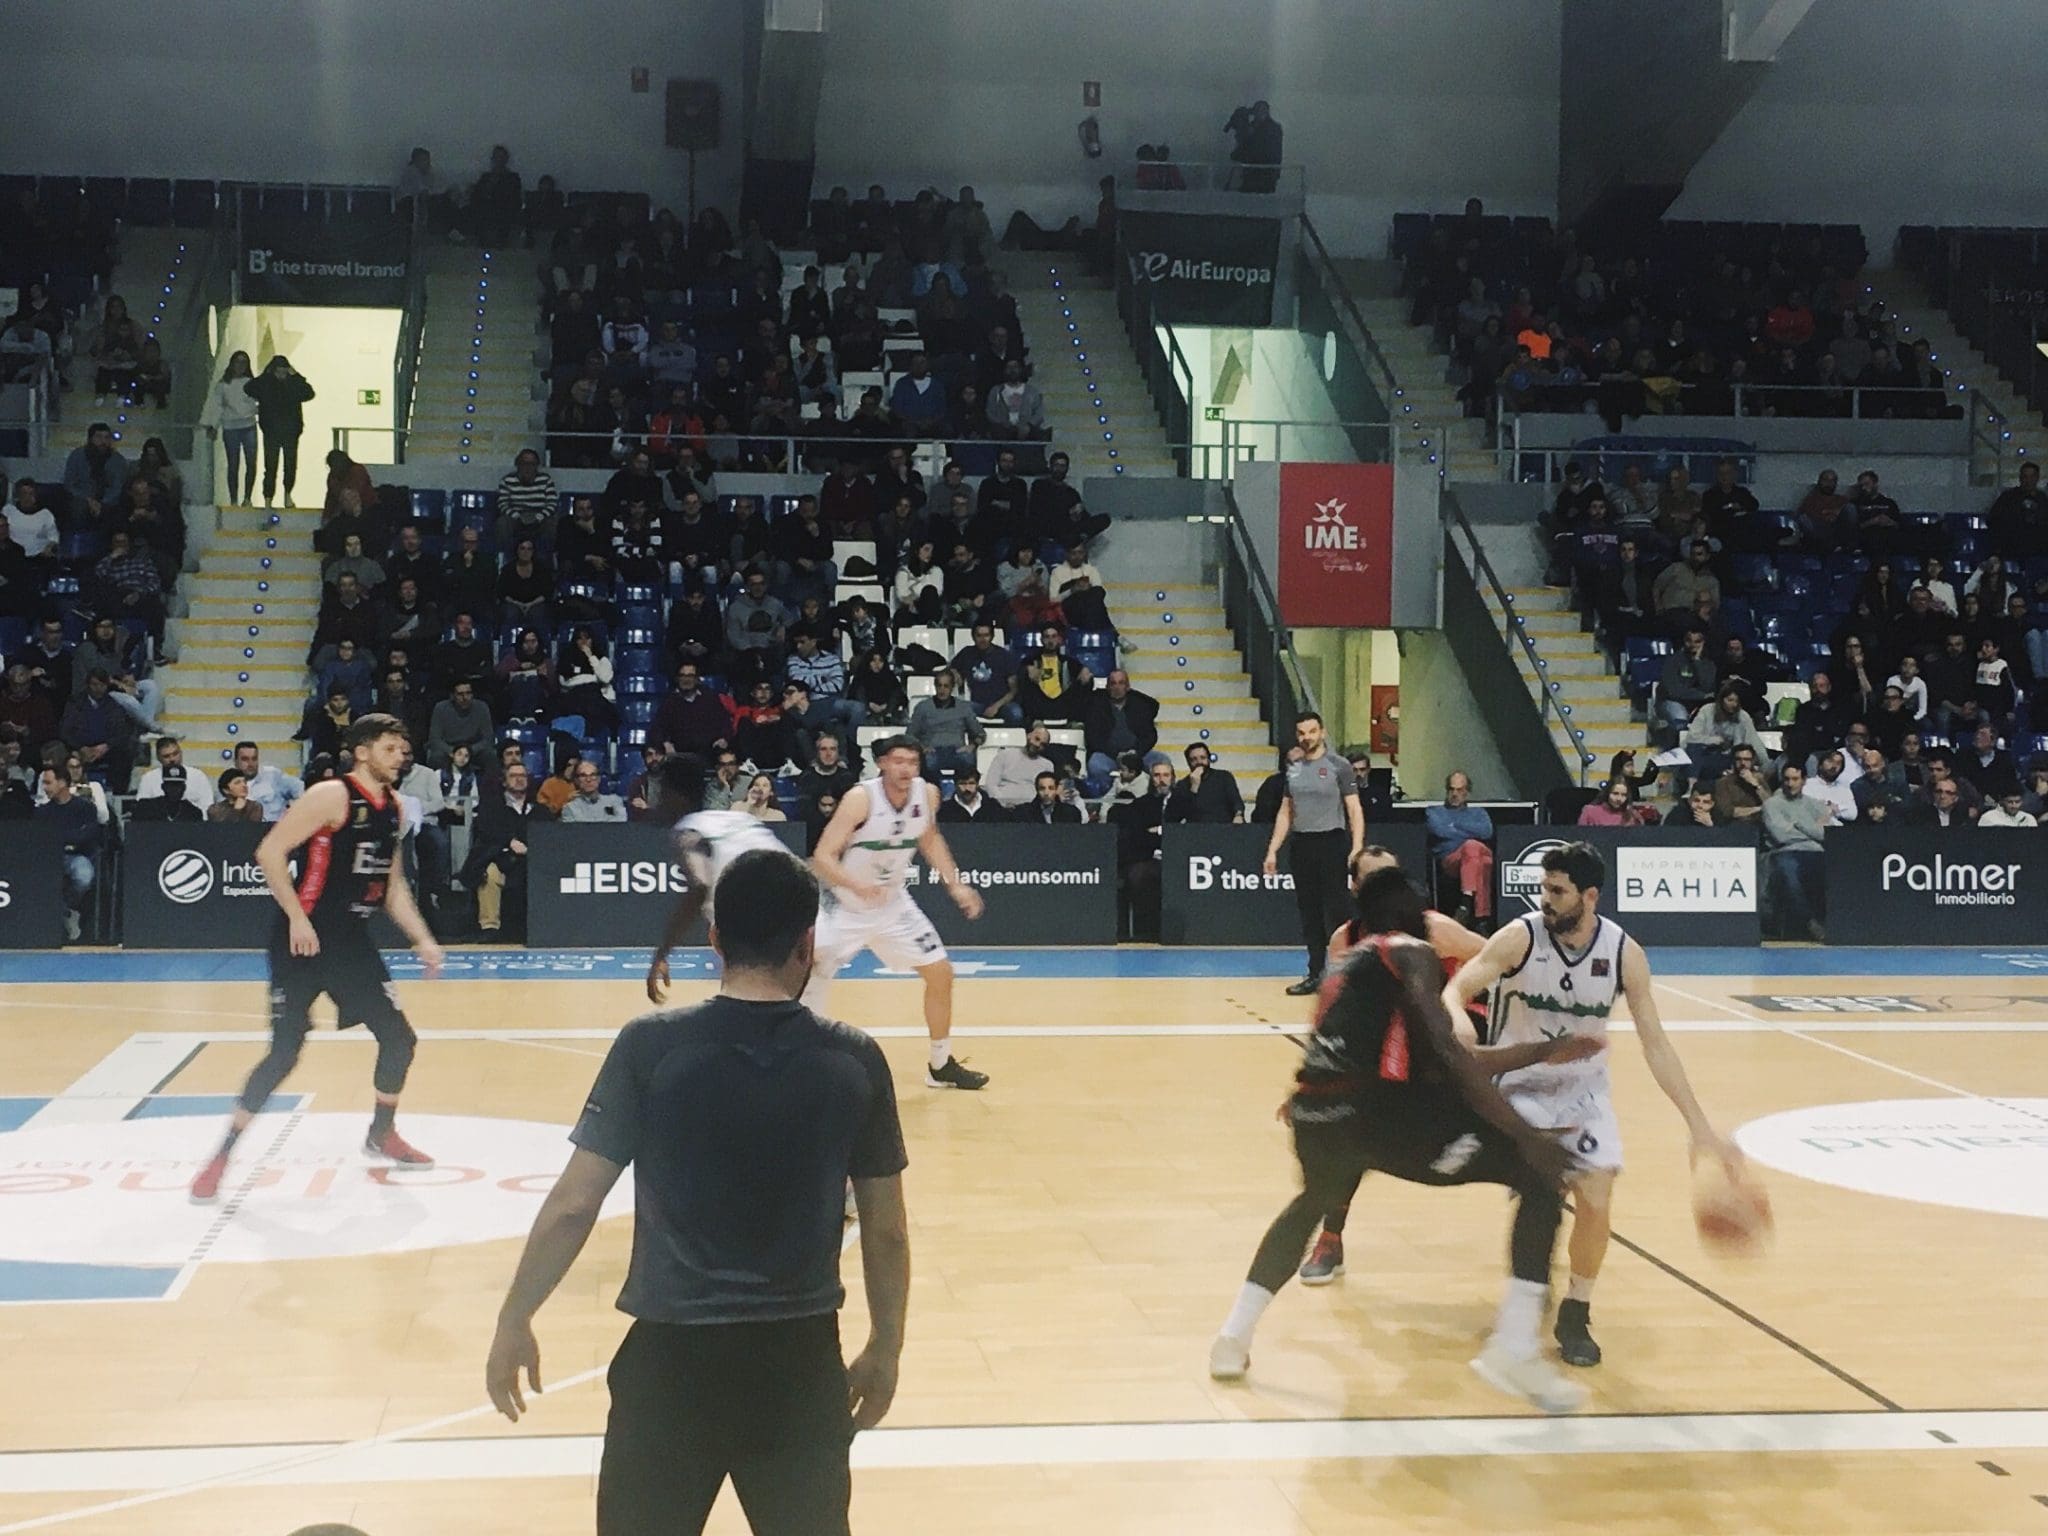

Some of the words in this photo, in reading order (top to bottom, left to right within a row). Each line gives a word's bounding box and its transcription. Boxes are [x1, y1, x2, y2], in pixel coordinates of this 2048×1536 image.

[273, 260, 300, 275] the
[304, 261, 350, 277] travel
[354, 262, 406, 278] brand
[1170, 259, 1271, 287] AirEuropa
[1305, 525, 1359, 549] IME
[1632, 860, 1742, 870] IMPRENTA
[1882, 853, 2022, 891] Palmer
[928, 867, 1101, 888] #iatgeaunsomni
[1221, 869, 1259, 890] the
[1263, 872, 1296, 890] tra
[1626, 878, 1747, 898] BAHIA
